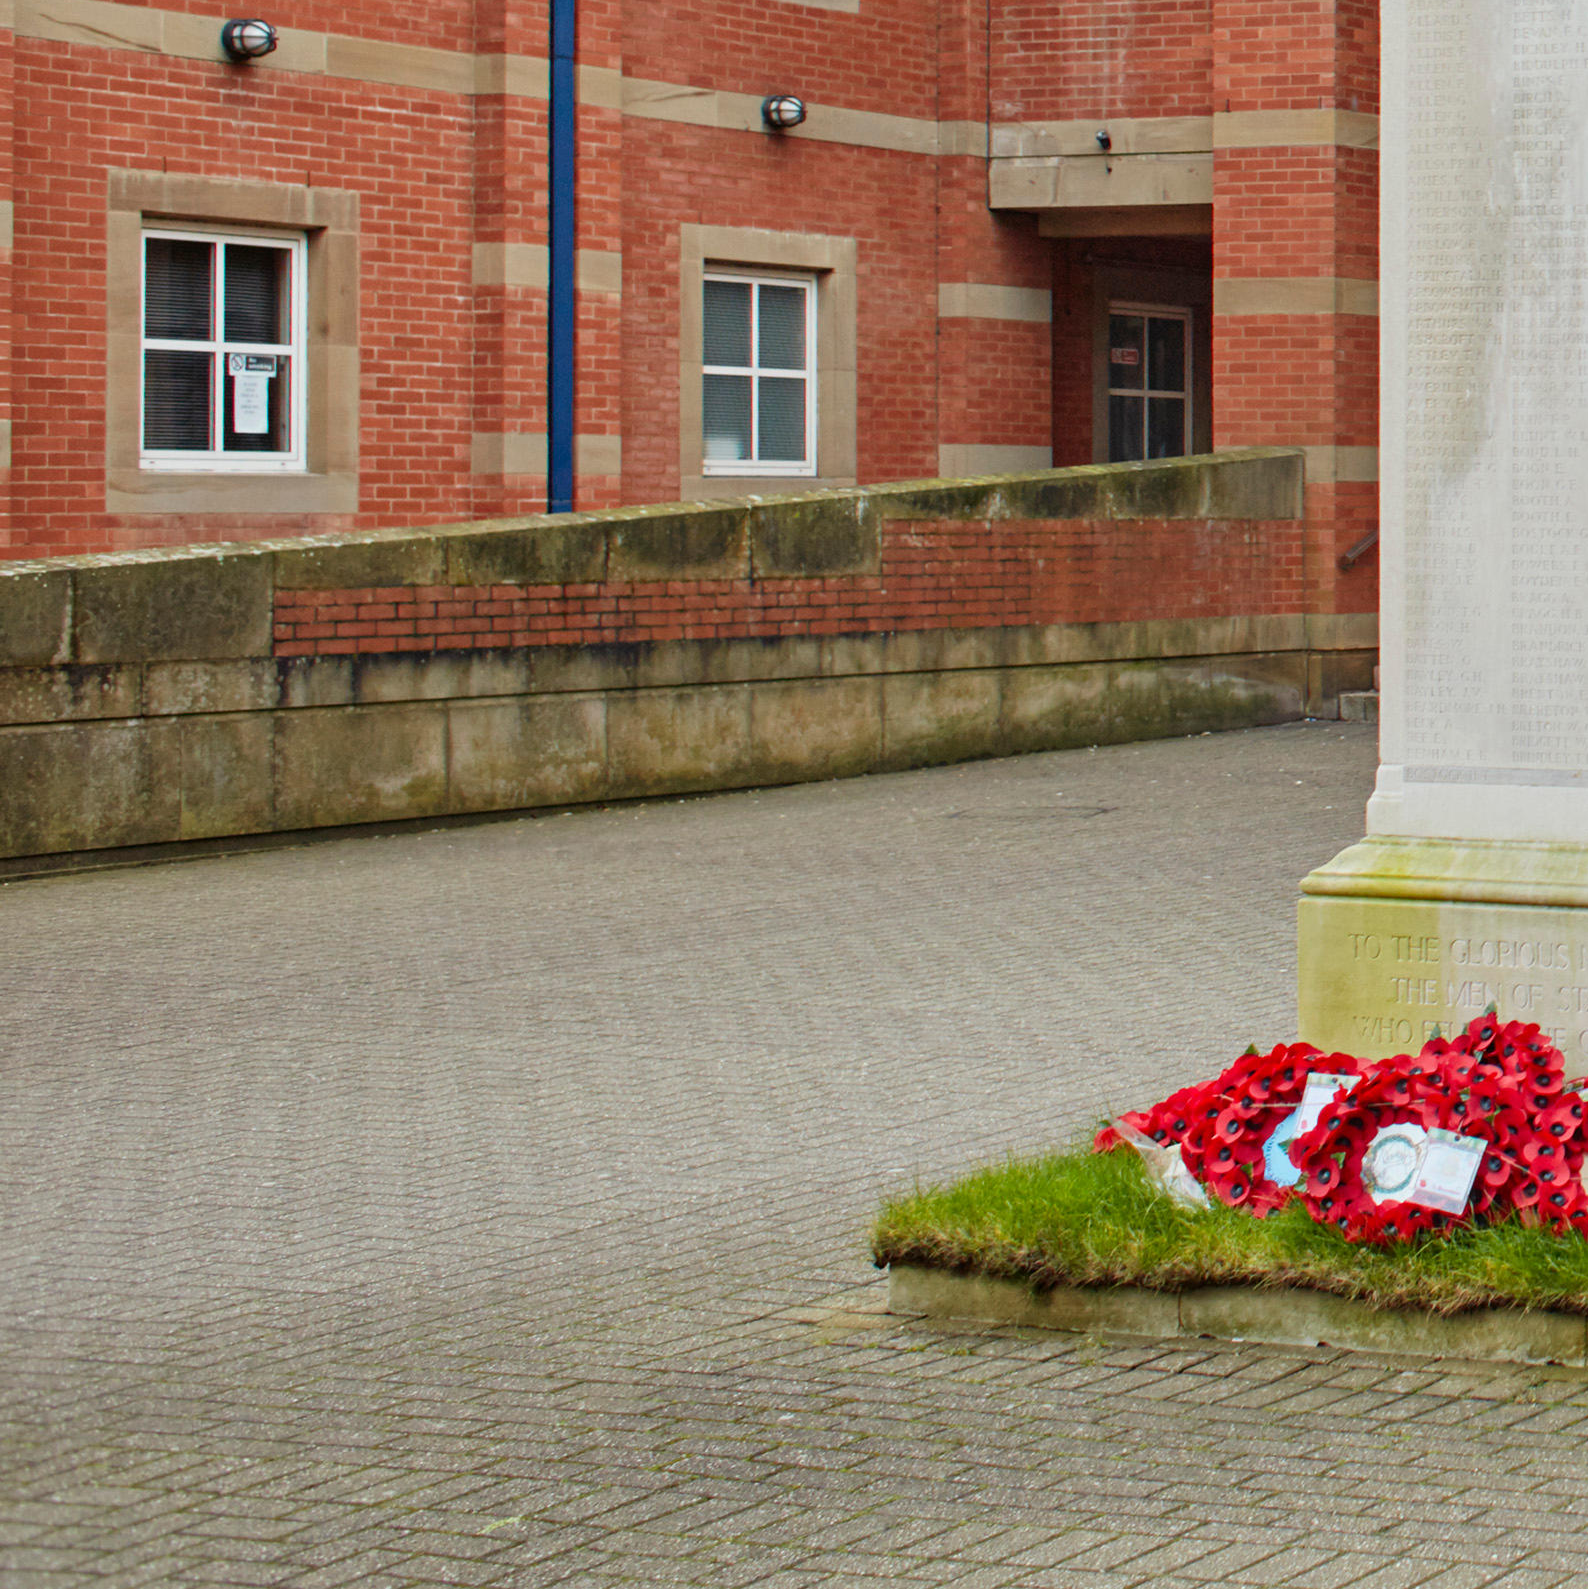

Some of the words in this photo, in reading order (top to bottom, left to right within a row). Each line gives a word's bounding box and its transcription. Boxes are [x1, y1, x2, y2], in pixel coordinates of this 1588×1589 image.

[1348, 933, 1382, 961] TO
[1391, 934, 1441, 964] THE
[1449, 938, 1569, 971] GLORIOUS
[1389, 977, 1437, 1006] THE
[1446, 980, 1501, 1009] MEN
[1511, 983, 1546, 1010] OF
[1352, 1016, 1413, 1045] WHO
